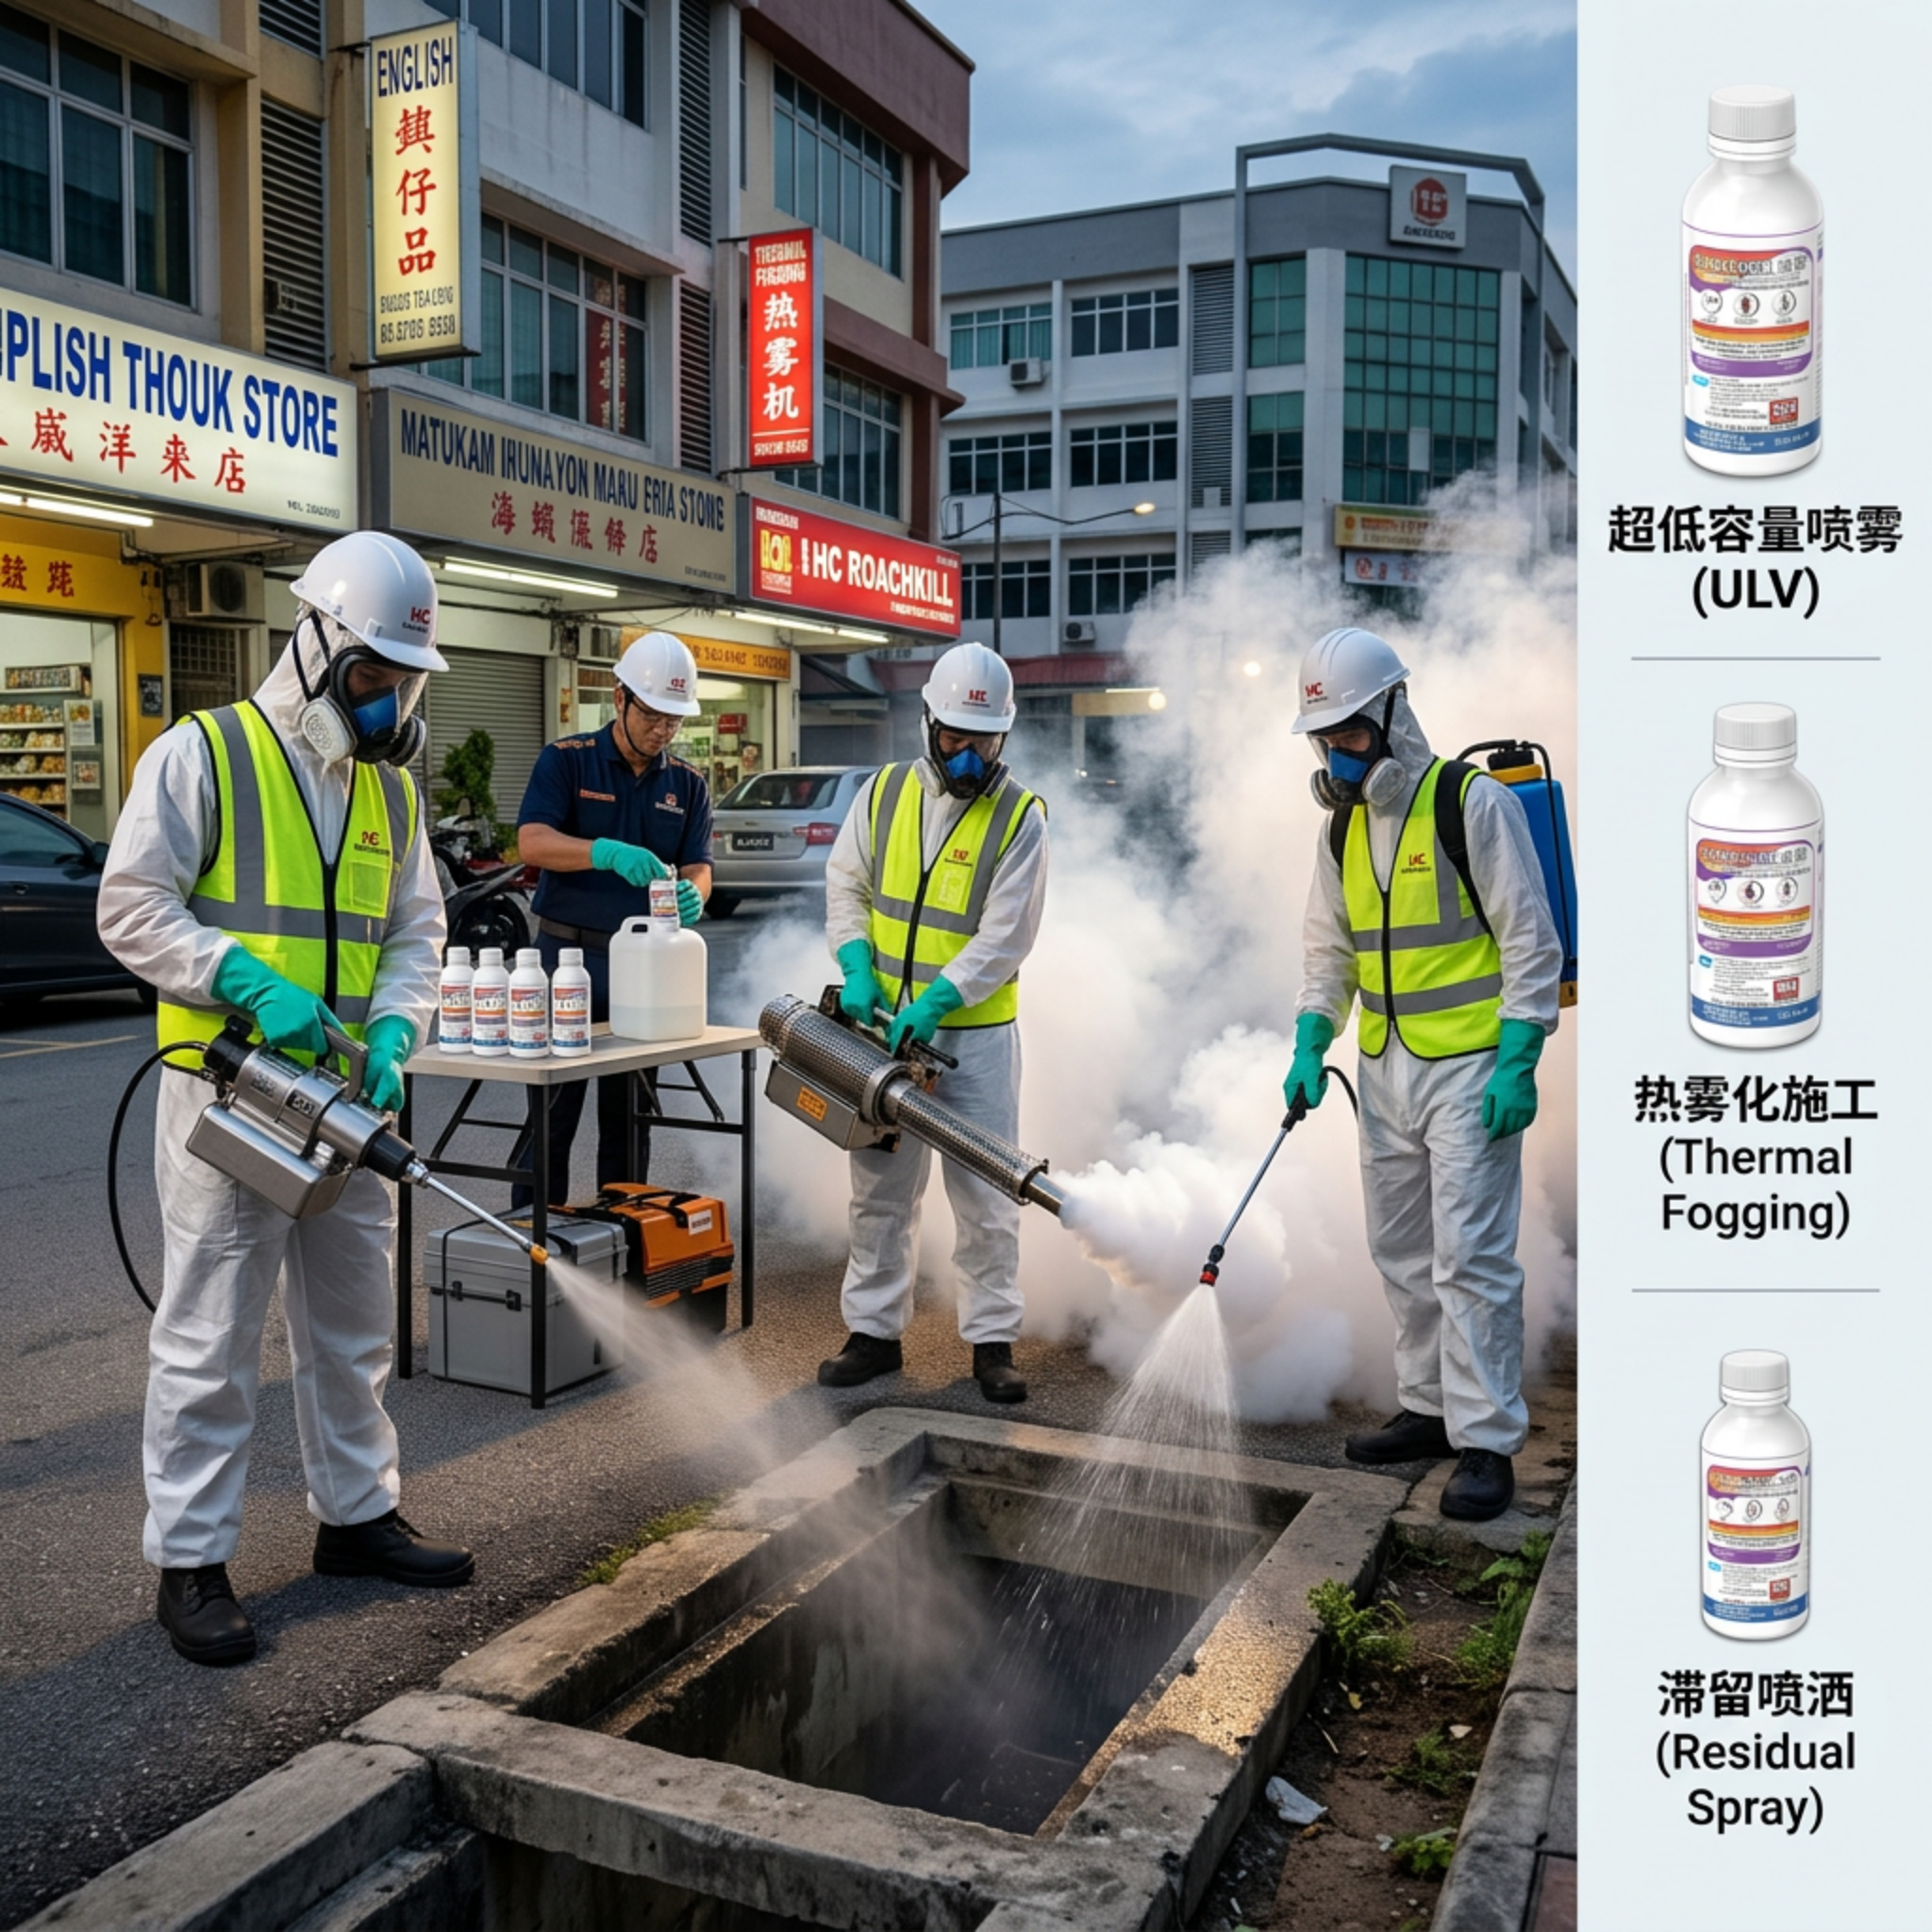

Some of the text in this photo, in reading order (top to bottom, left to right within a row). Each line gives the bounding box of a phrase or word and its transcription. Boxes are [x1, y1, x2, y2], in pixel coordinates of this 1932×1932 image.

[378, 36, 453, 97] ENGLISH
[0, 308, 339, 458] PLISH THOUK STORE
[763, 291, 799, 422] 热雾机
[401, 408, 495, 476] MATUKAM
[593, 461, 639, 510] MARU
[812, 541, 842, 583] HC
[847, 549, 954, 608] ROACHKILL
